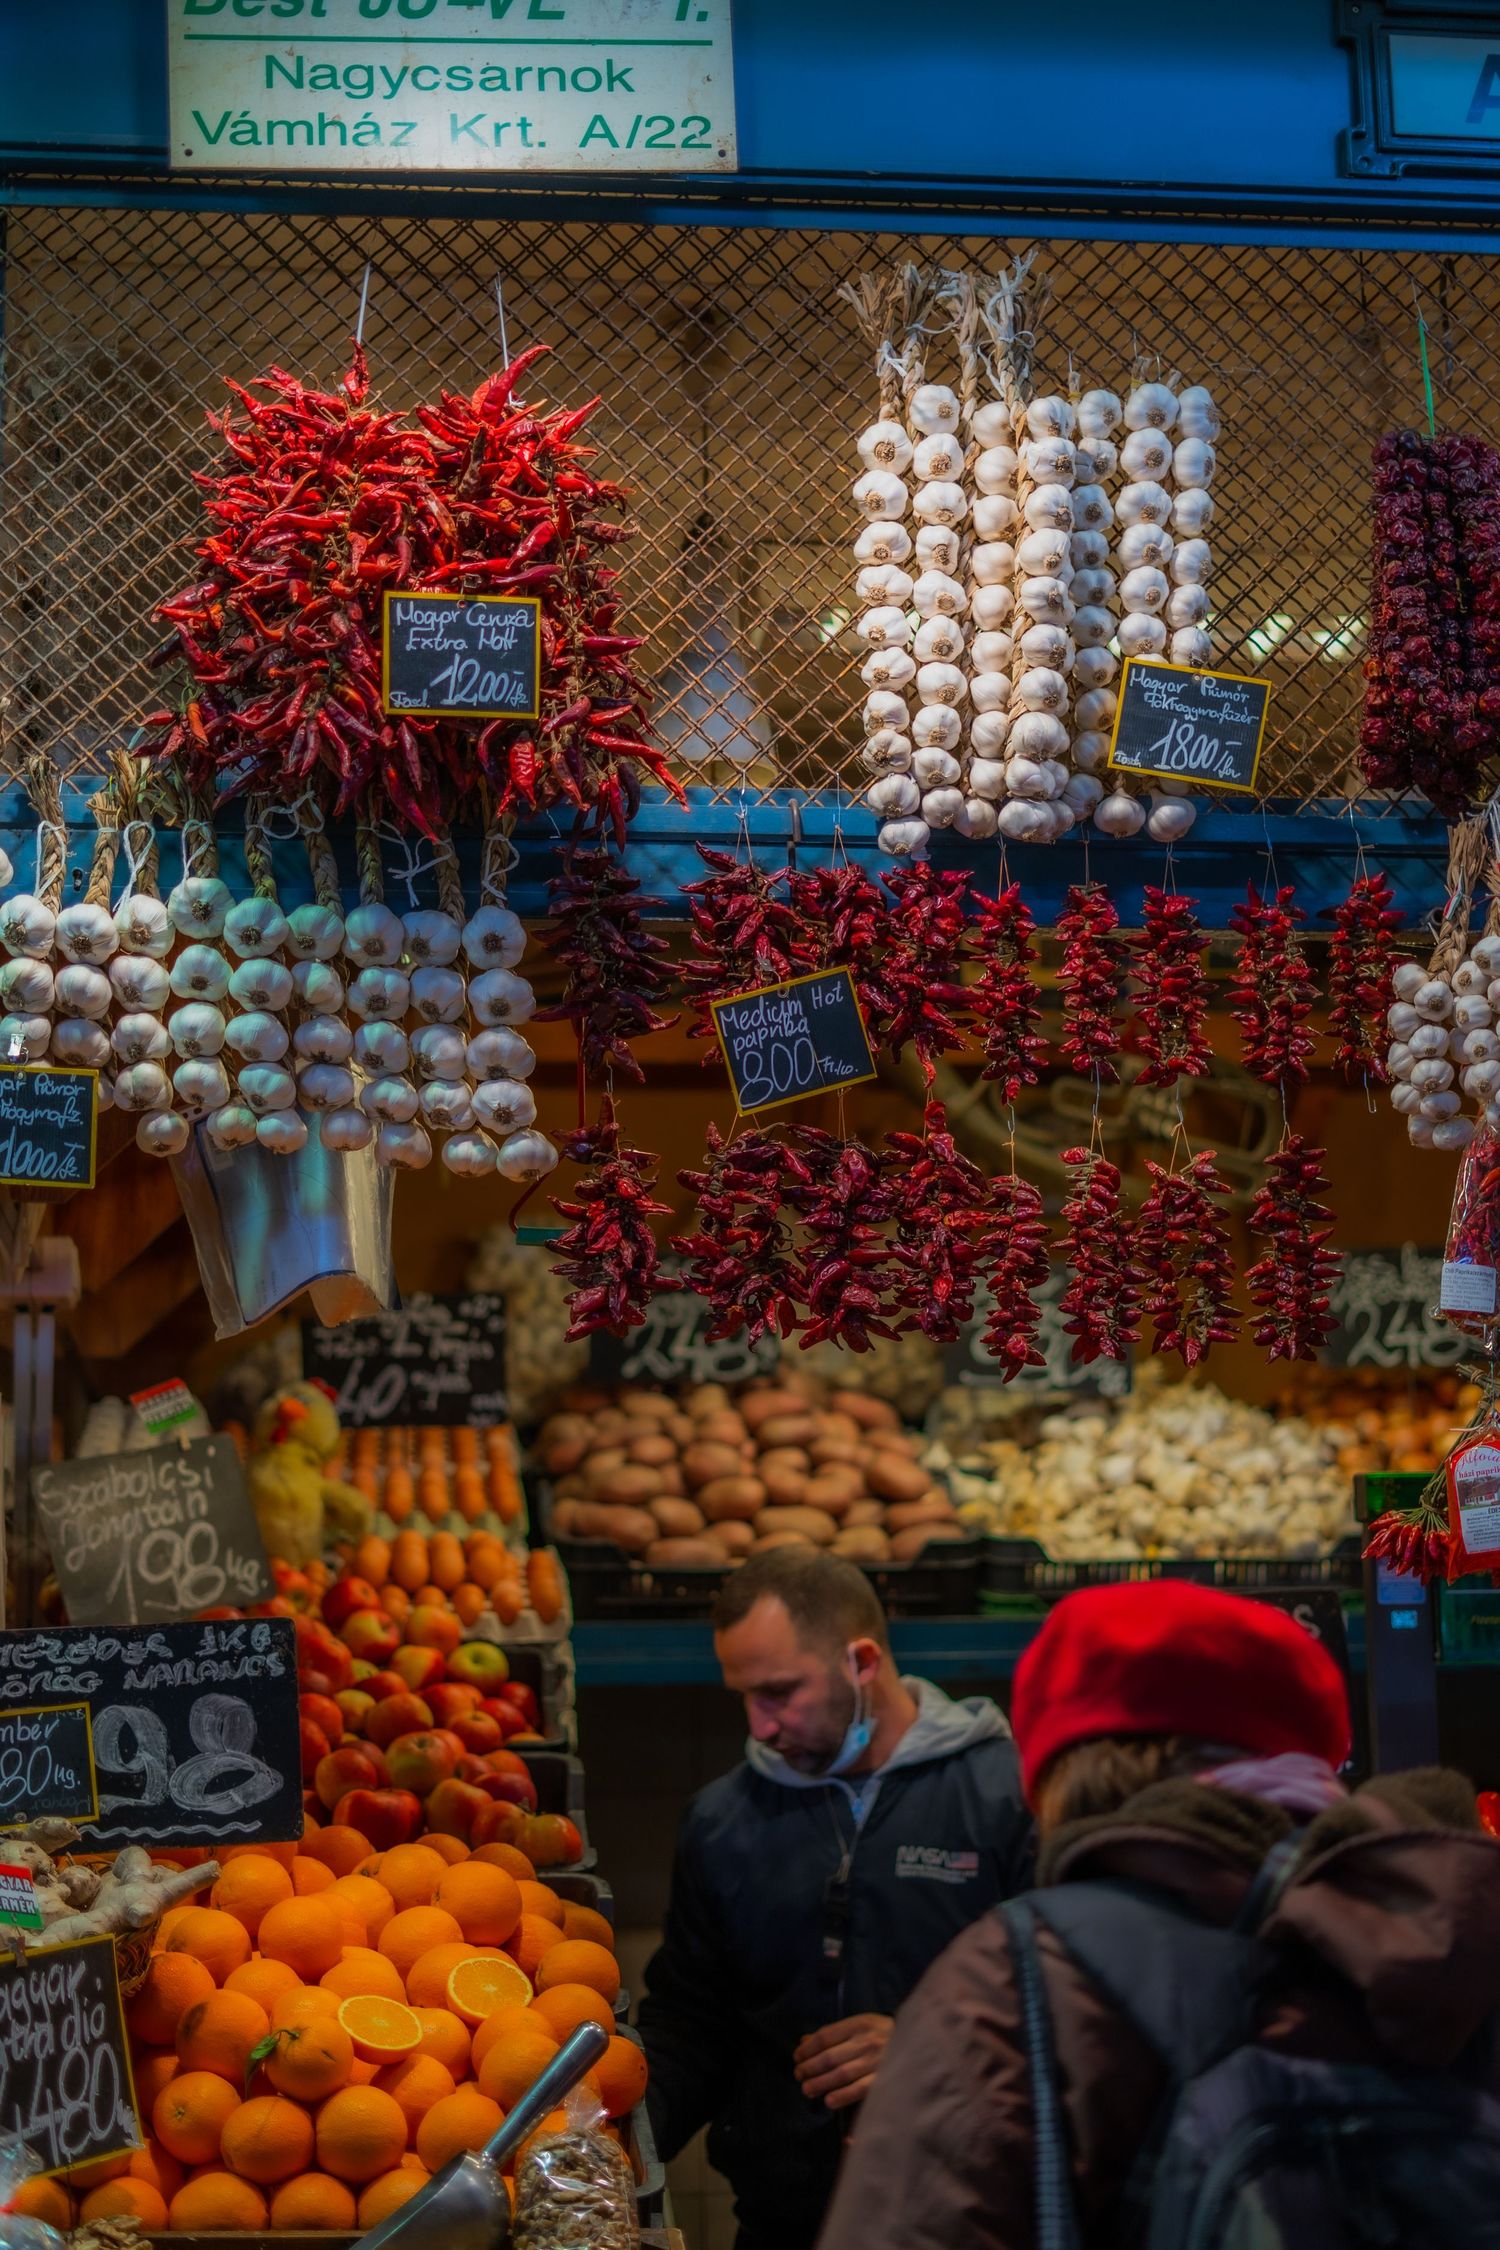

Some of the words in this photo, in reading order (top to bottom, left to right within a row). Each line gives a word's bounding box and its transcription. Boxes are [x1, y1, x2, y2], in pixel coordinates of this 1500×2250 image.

[264, 55, 635, 99] Nagycsarnok
[191, 110, 419, 147] Vámház
[449, 113, 546, 149] Krt.
[578, 114, 713, 150] A/22
[405, 627, 468, 651] Extra
[1129, 667, 1188, 694] Magyar
[719, 995, 804, 1038] Medium
[810, 980, 845, 1010] Hot
[732, 1012, 811, 1060] paprika
[737, 1036, 816, 1109] 800
